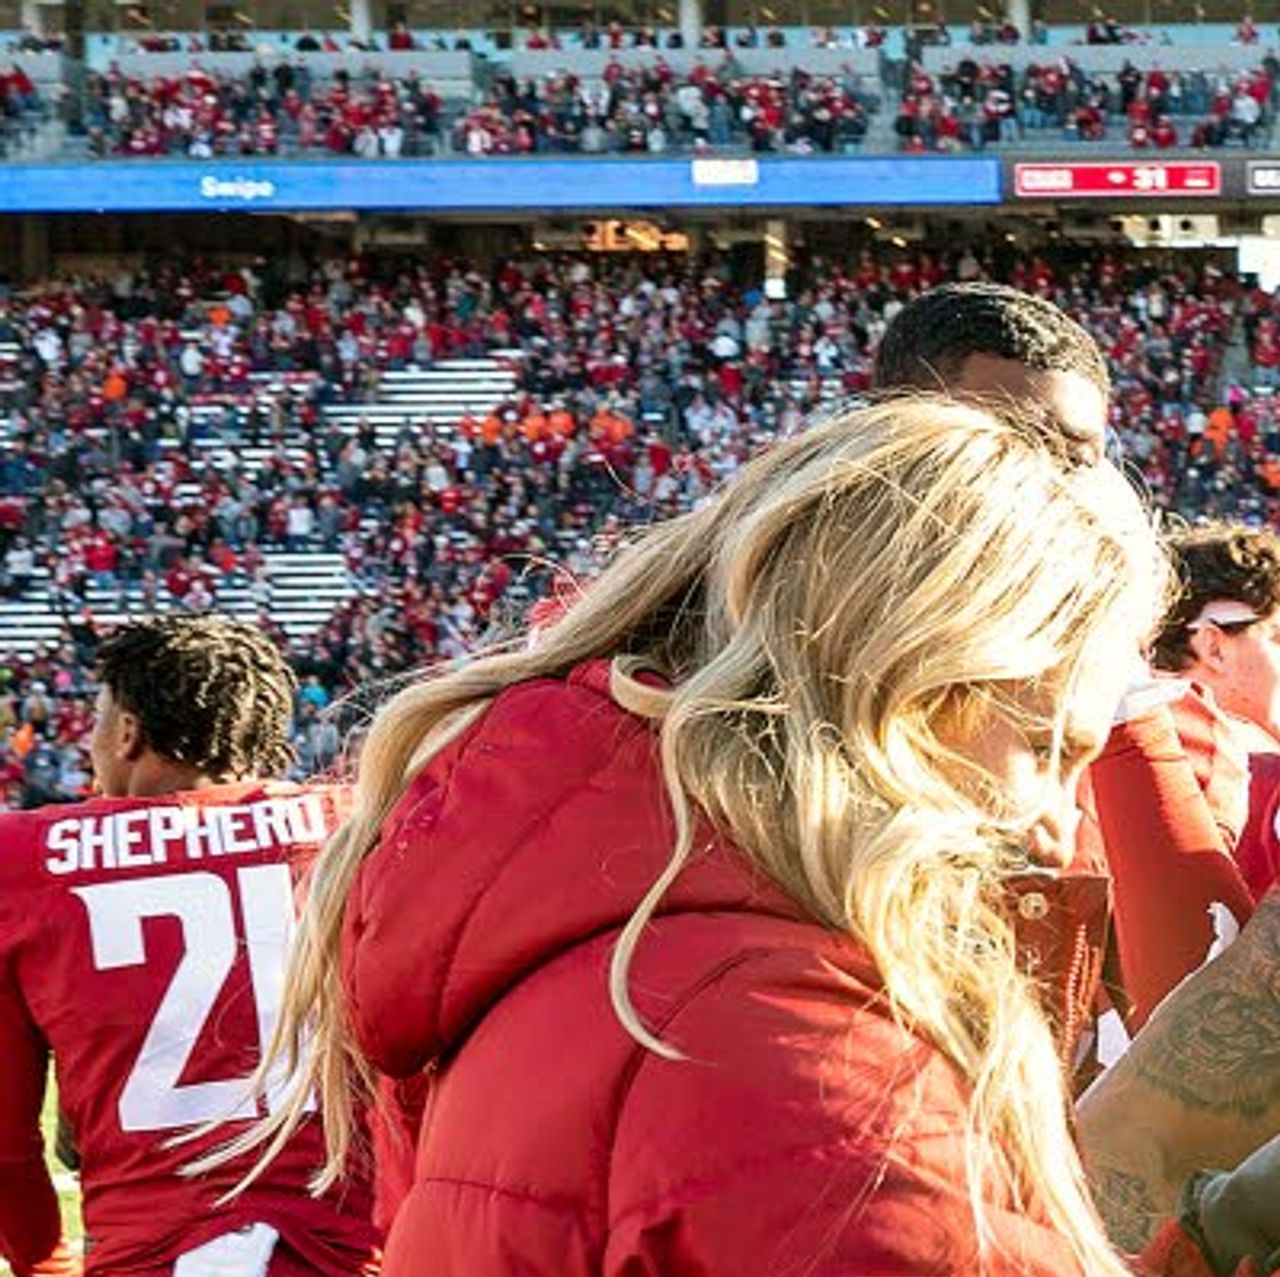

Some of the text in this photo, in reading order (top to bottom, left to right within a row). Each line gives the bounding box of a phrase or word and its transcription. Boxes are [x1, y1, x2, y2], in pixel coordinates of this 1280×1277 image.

[201, 176, 274, 200] Swipe
[1133, 167, 1167, 190] 31
[45, 796, 328, 876] SHEPHERD
[69, 862, 318, 1133] 21
